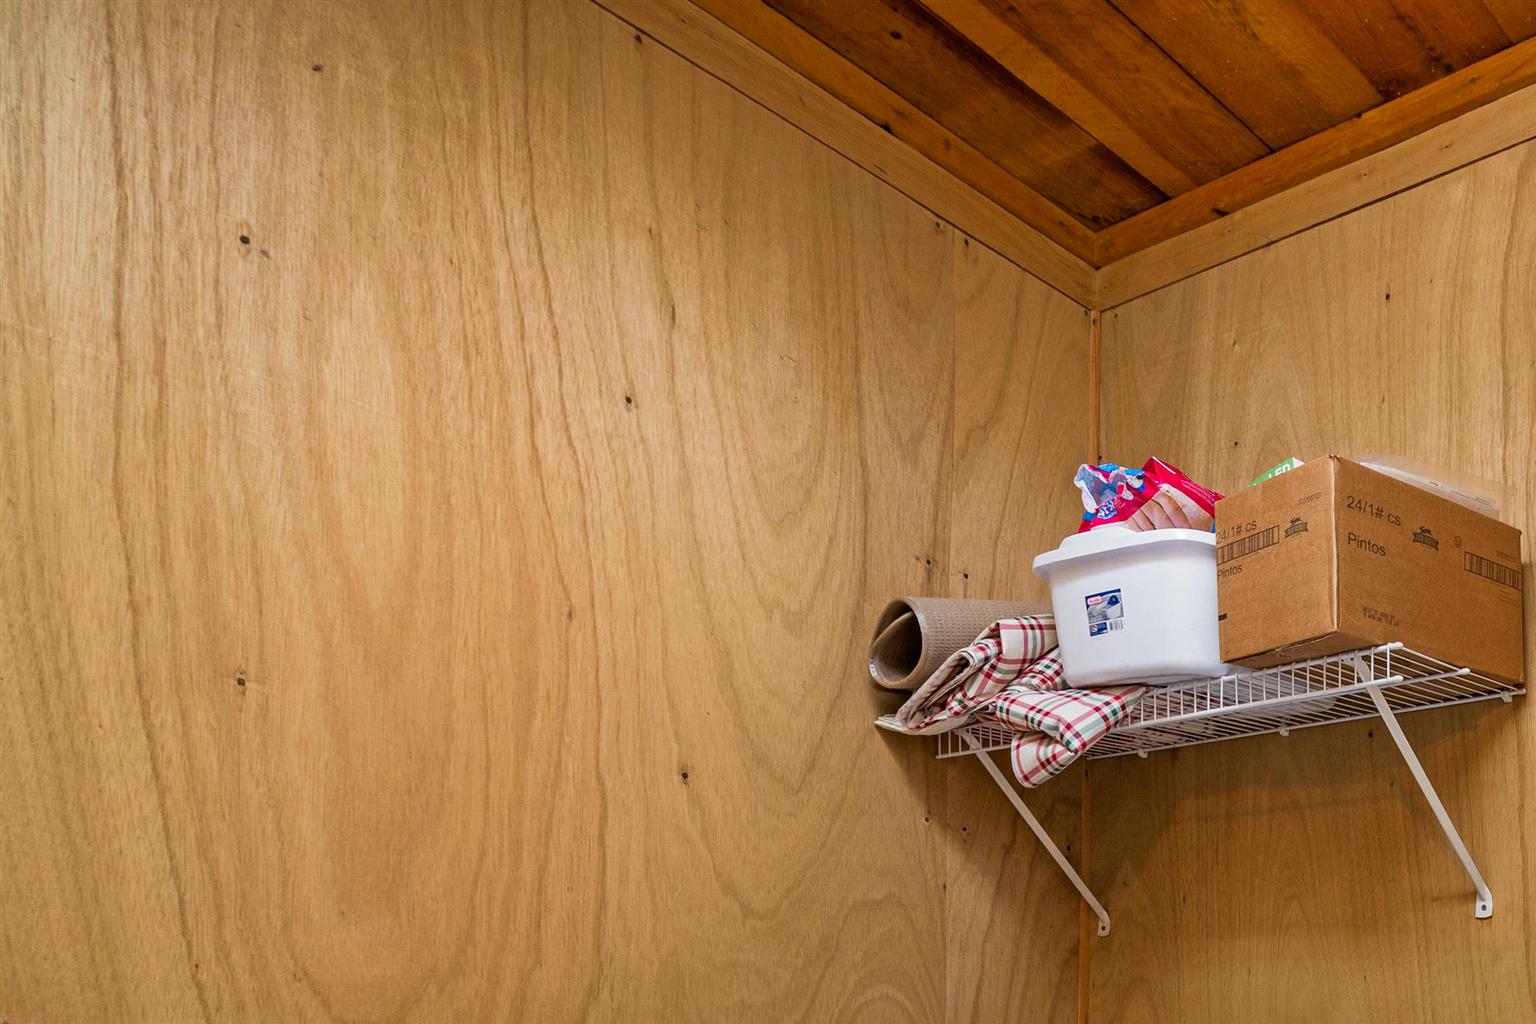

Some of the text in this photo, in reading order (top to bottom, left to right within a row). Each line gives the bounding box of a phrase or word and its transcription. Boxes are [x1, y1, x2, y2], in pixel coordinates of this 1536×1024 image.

[1347, 495, 1384, 520] 24/1#
[1347, 532, 1387, 557] Pintos
[1217, 564, 1243, 580] Pintos
